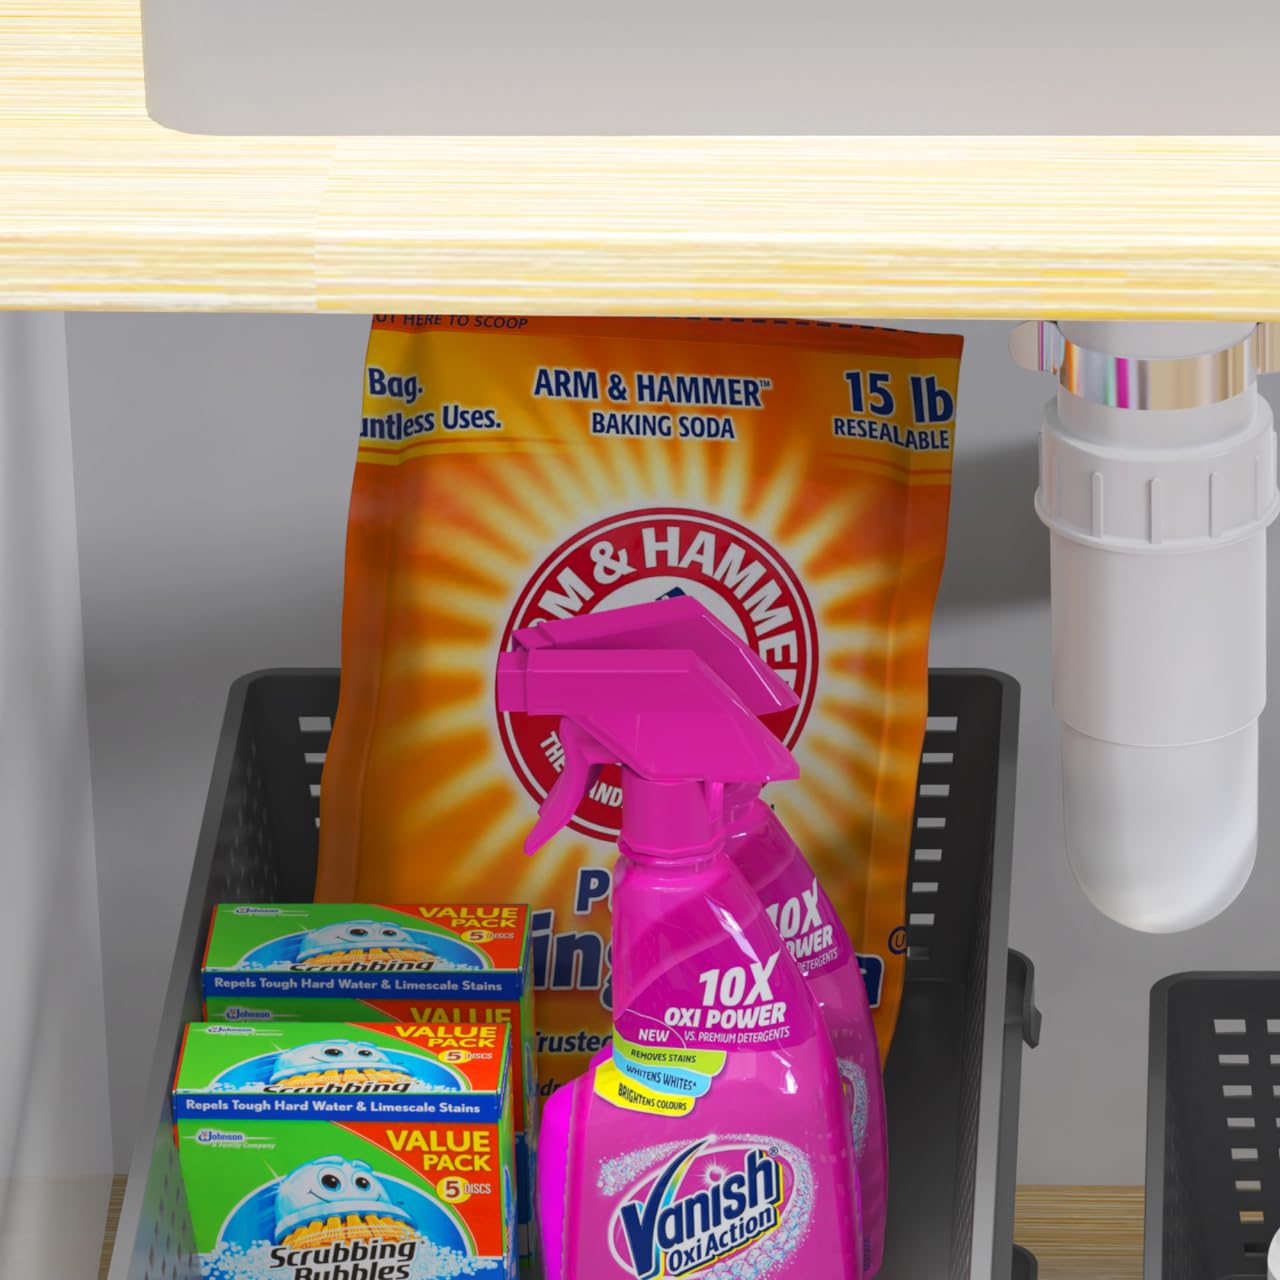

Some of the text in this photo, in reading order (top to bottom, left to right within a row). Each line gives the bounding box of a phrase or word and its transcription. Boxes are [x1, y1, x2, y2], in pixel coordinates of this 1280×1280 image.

[403, 314, 441, 326] HERE
[449, 315, 470, 326] TO
[474, 316, 528, 329] SCOOP
[368, 367, 423, 404] Bag.
[534, 368, 598, 399] ARM
[607, 373, 628, 401] &
[845, 371, 954, 423] 15 lb
[442, 405, 502, 430] Uses.
[592, 412, 735, 439] BAKING SODA
[833, 418, 950, 450] RESEALABLE
[590, 541, 636, 584] &
[418, 907, 519, 918] VALUE
[451, 919, 517, 928] PACK
[469, 931, 485, 941] 5
[214, 977, 503, 991] Repels Tough Hard Water & Limescale Stains
[698, 948, 781, 1007] 10X
[664, 1002, 787, 1029] OXI POWER
[395, 1026, 497, 1038] VALUE
[638, 1028, 670, 1042] NEW
[684, 1026, 790, 1043] VS. PREMIUM DETERGENTS
[427, 1039, 496, 1048] PACK
[446, 1051, 462, 1061] 5
[631, 1049, 697, 1064] REMOVES STAINS
[626, 1065, 661, 1083] WHITENS
[186, 1099, 481, 1113] Repels Tough Hard Water & Limescale Stains
[618, 1083, 687, 1111] BRIGHTENS COLOURS
[385, 1130, 491, 1152] VALUE
[423, 1154, 492, 1171] PACK
[445, 1180, 492, 1199] 5 DISCS
[269, 1239, 416, 1269] Scrubbing
